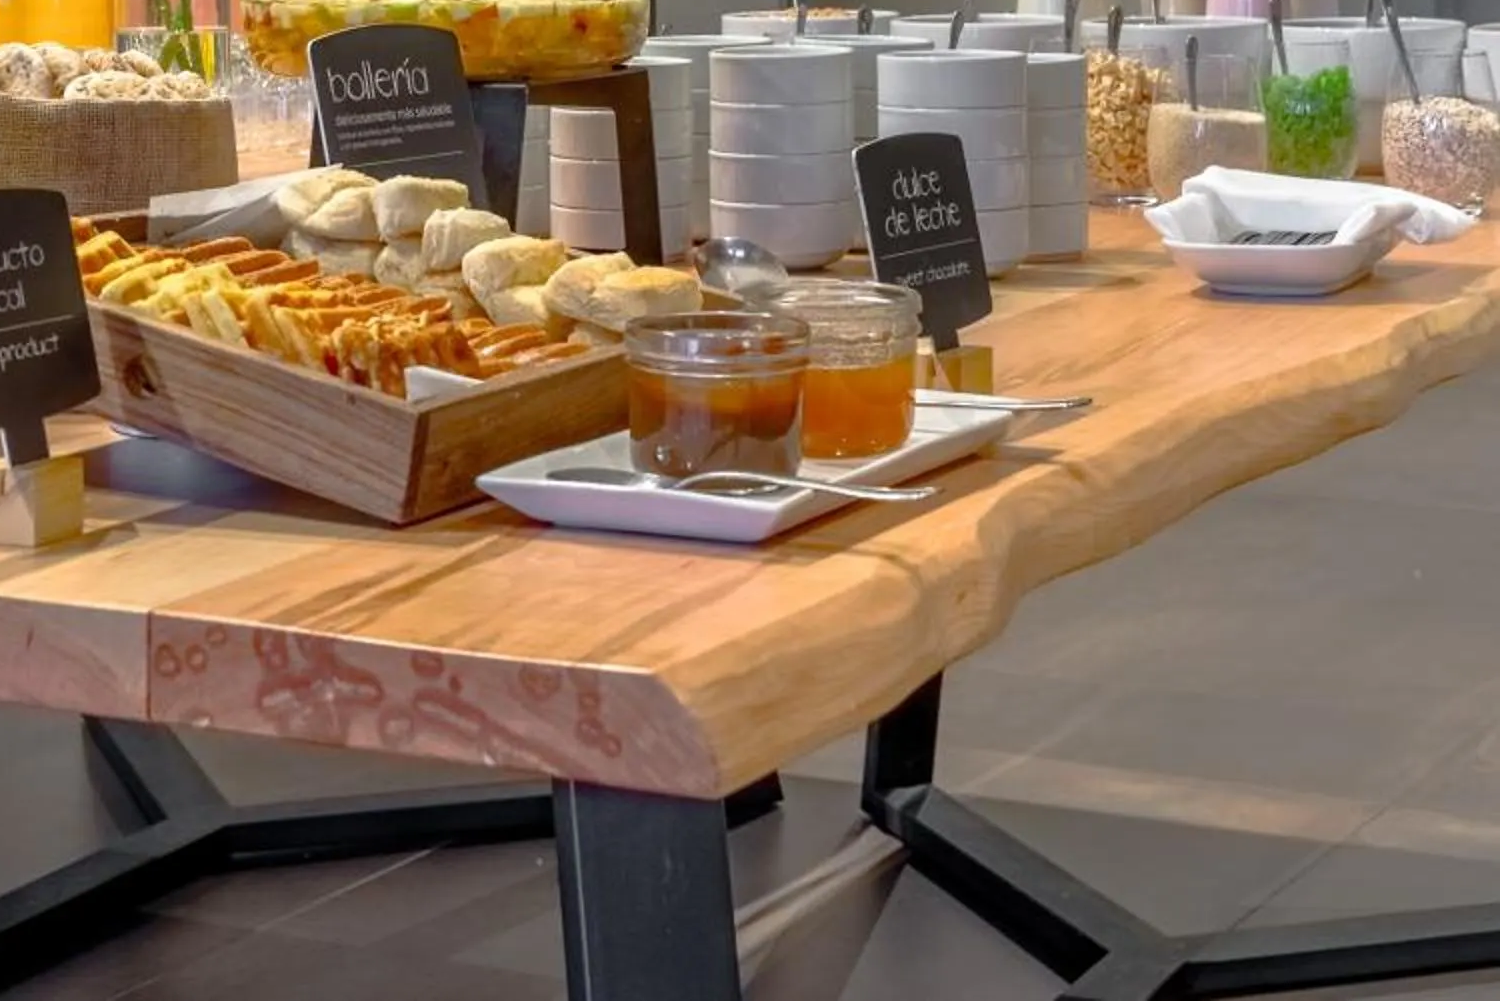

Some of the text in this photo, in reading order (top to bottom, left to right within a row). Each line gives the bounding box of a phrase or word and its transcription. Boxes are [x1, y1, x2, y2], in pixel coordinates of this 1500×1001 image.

[327, 57, 429, 103] bollería
[892, 166, 942, 200] dulce
[885, 200, 962, 238] de leche
